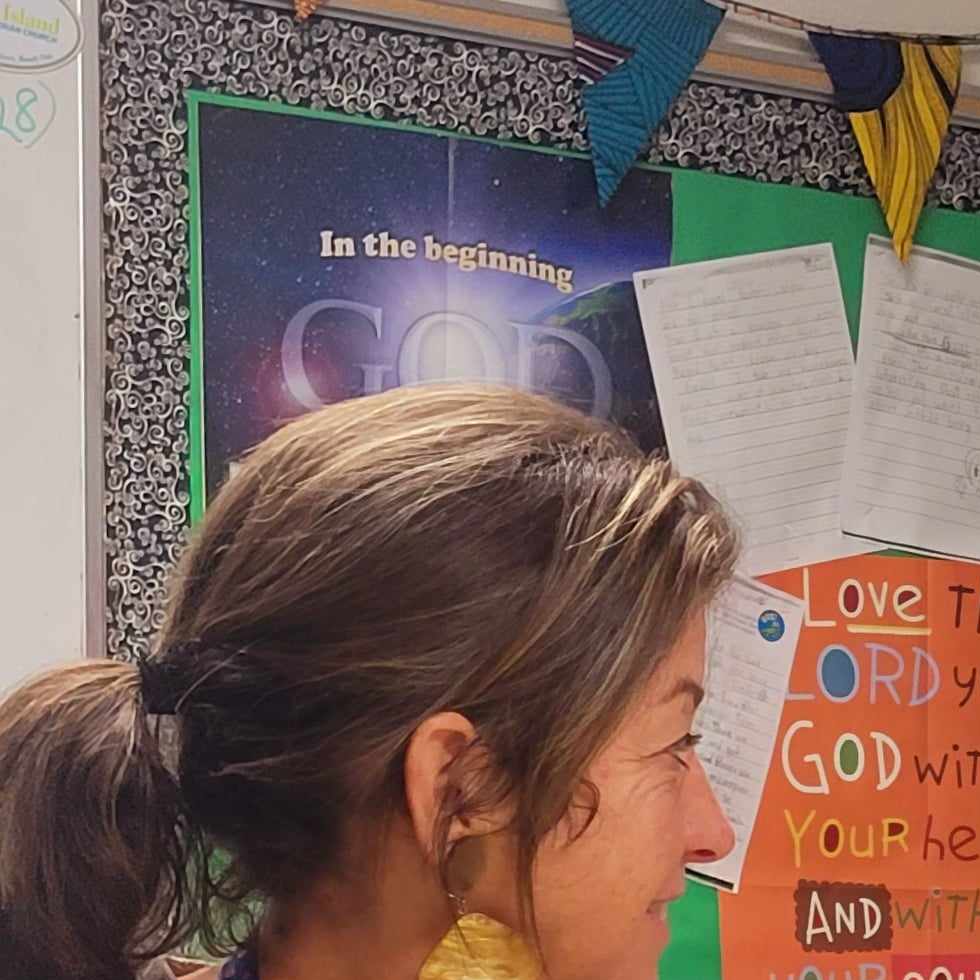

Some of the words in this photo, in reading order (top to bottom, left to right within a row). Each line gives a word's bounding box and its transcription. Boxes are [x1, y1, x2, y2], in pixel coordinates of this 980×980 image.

[319, 230, 355, 258] In
[364, 232, 416, 259] the
[424, 235, 573, 293] beginning
[281, 298, 613, 420] GOD
[802, 567, 926, 627] Love
[785, 642, 940, 707] ORD
[782, 720, 901, 795] GOD
